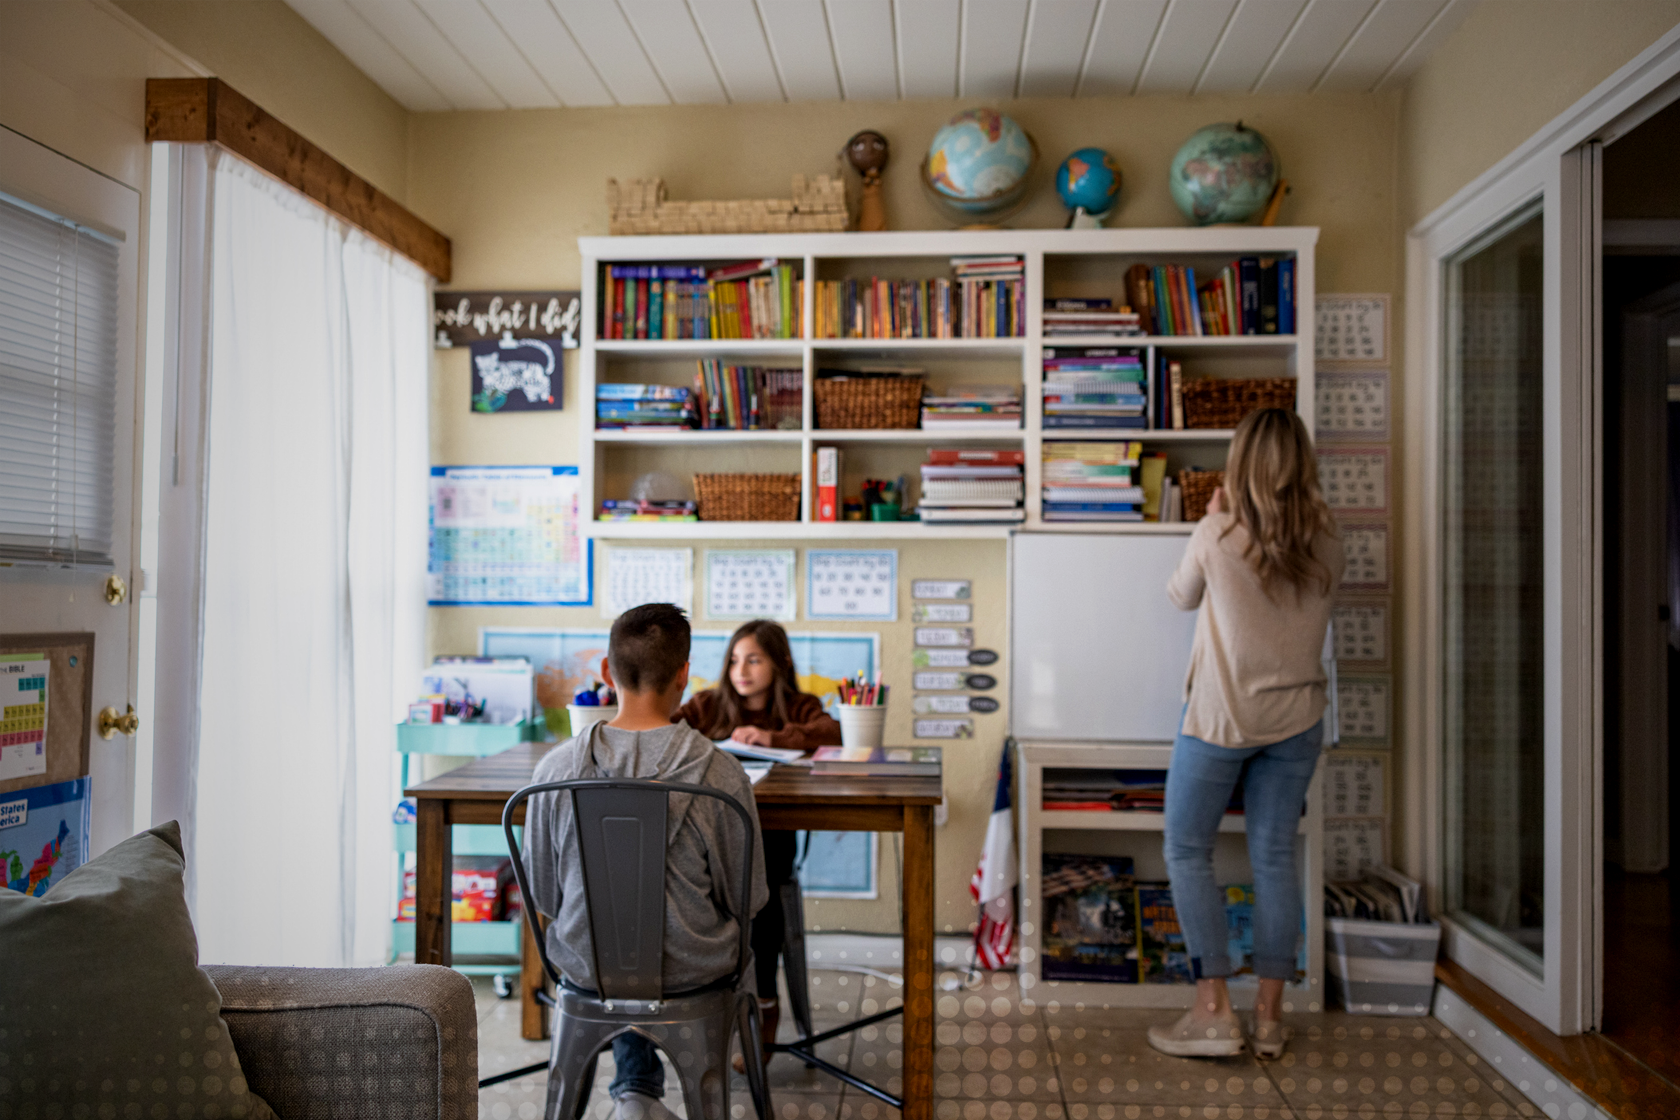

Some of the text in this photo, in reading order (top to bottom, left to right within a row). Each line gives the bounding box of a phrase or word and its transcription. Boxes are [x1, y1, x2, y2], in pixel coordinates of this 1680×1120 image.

[473, 295, 527, 336] what
[529, 301, 538, 331] I
[540, 297, 580, 335] did
[1, 803, 26, 816] States
[0, 813, 20, 827] erica
